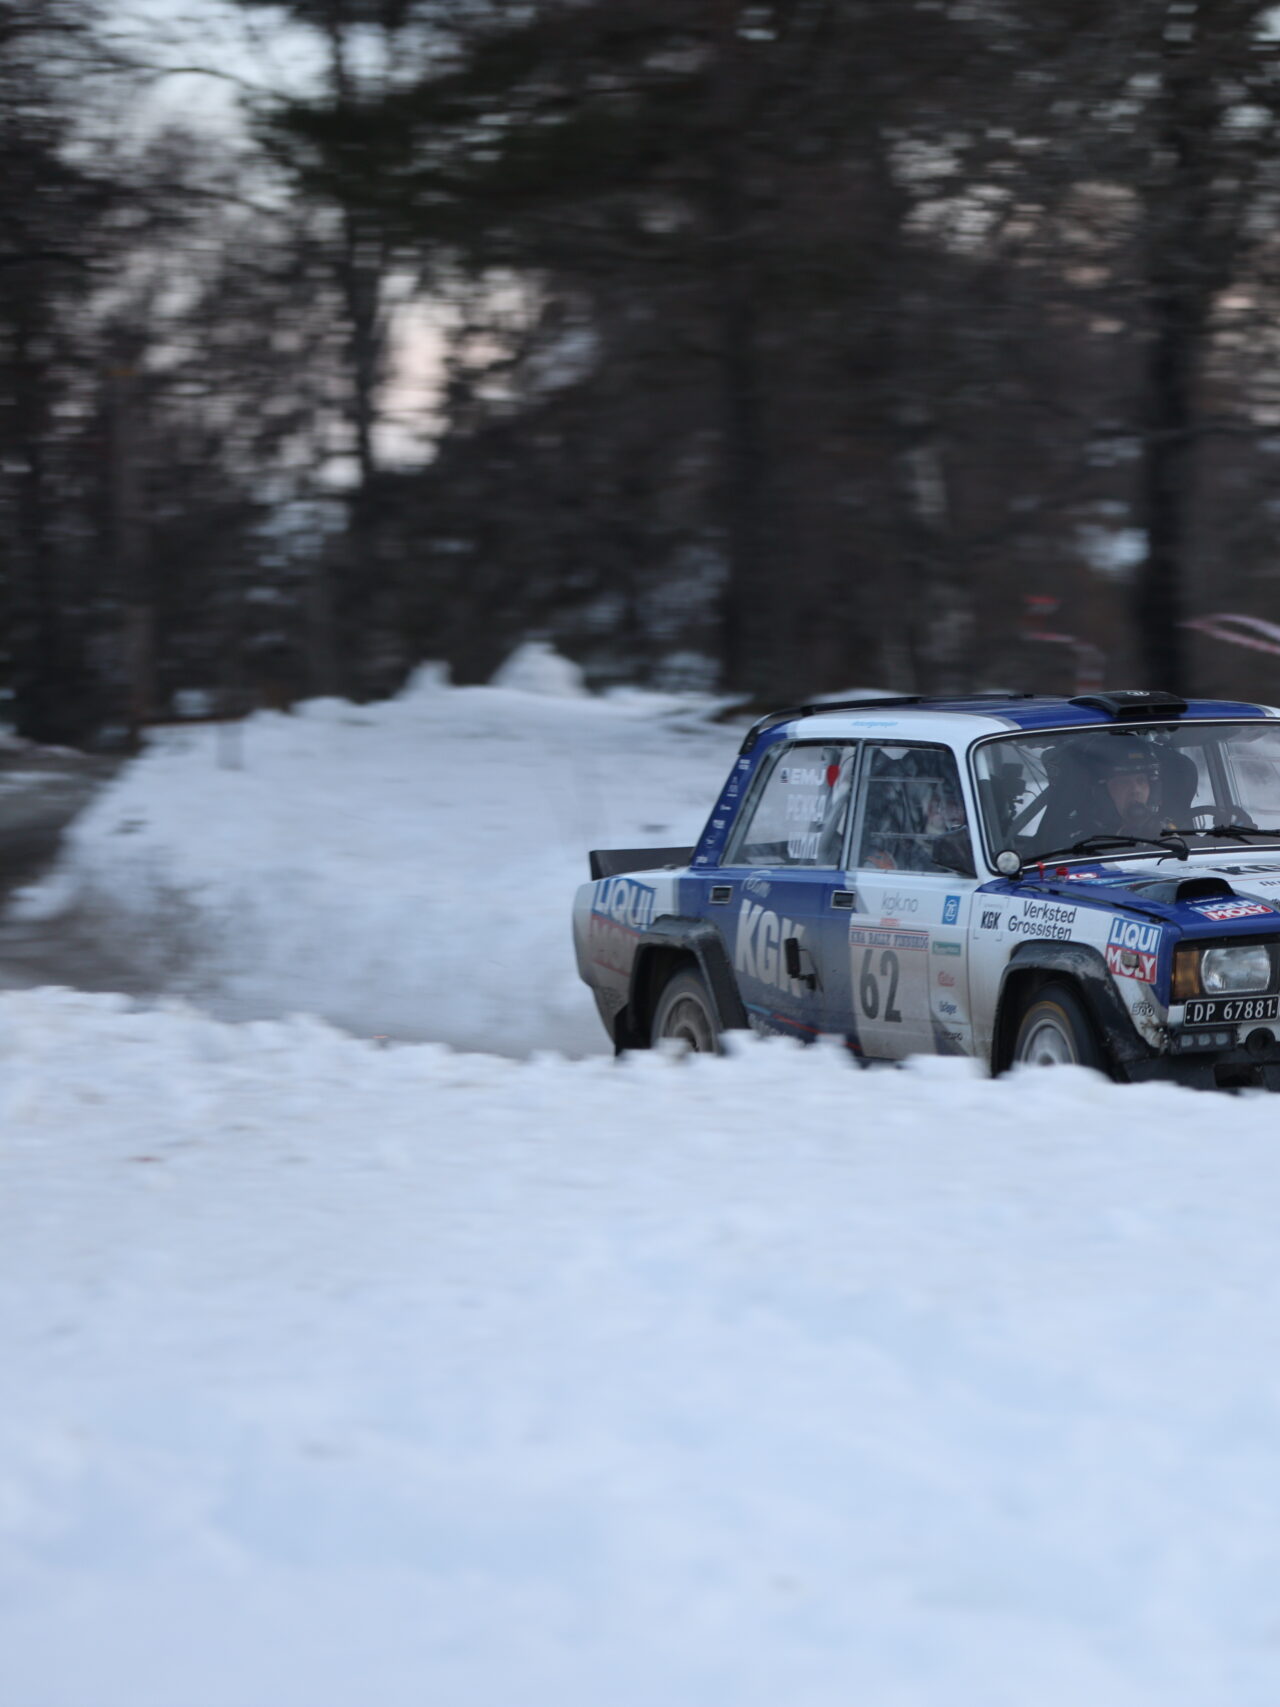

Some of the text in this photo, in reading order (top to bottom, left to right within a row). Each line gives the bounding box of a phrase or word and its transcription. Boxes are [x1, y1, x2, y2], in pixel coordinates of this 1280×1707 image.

[595, 879, 653, 930] LIQUI
[881, 891, 919, 916] kgk.no
[1023, 901, 1078, 924] Verksted
[1192, 900, 1256, 913] LIQUI
[1209, 905, 1269, 920] MOLY
[980, 911, 1002, 931] KGK
[1008, 915, 1072, 941] Grossisten
[1110, 919, 1160, 952] LIQUI
[860, 948, 903, 1023] 62
[1193, 999, 1273, 1022] DP 67881
